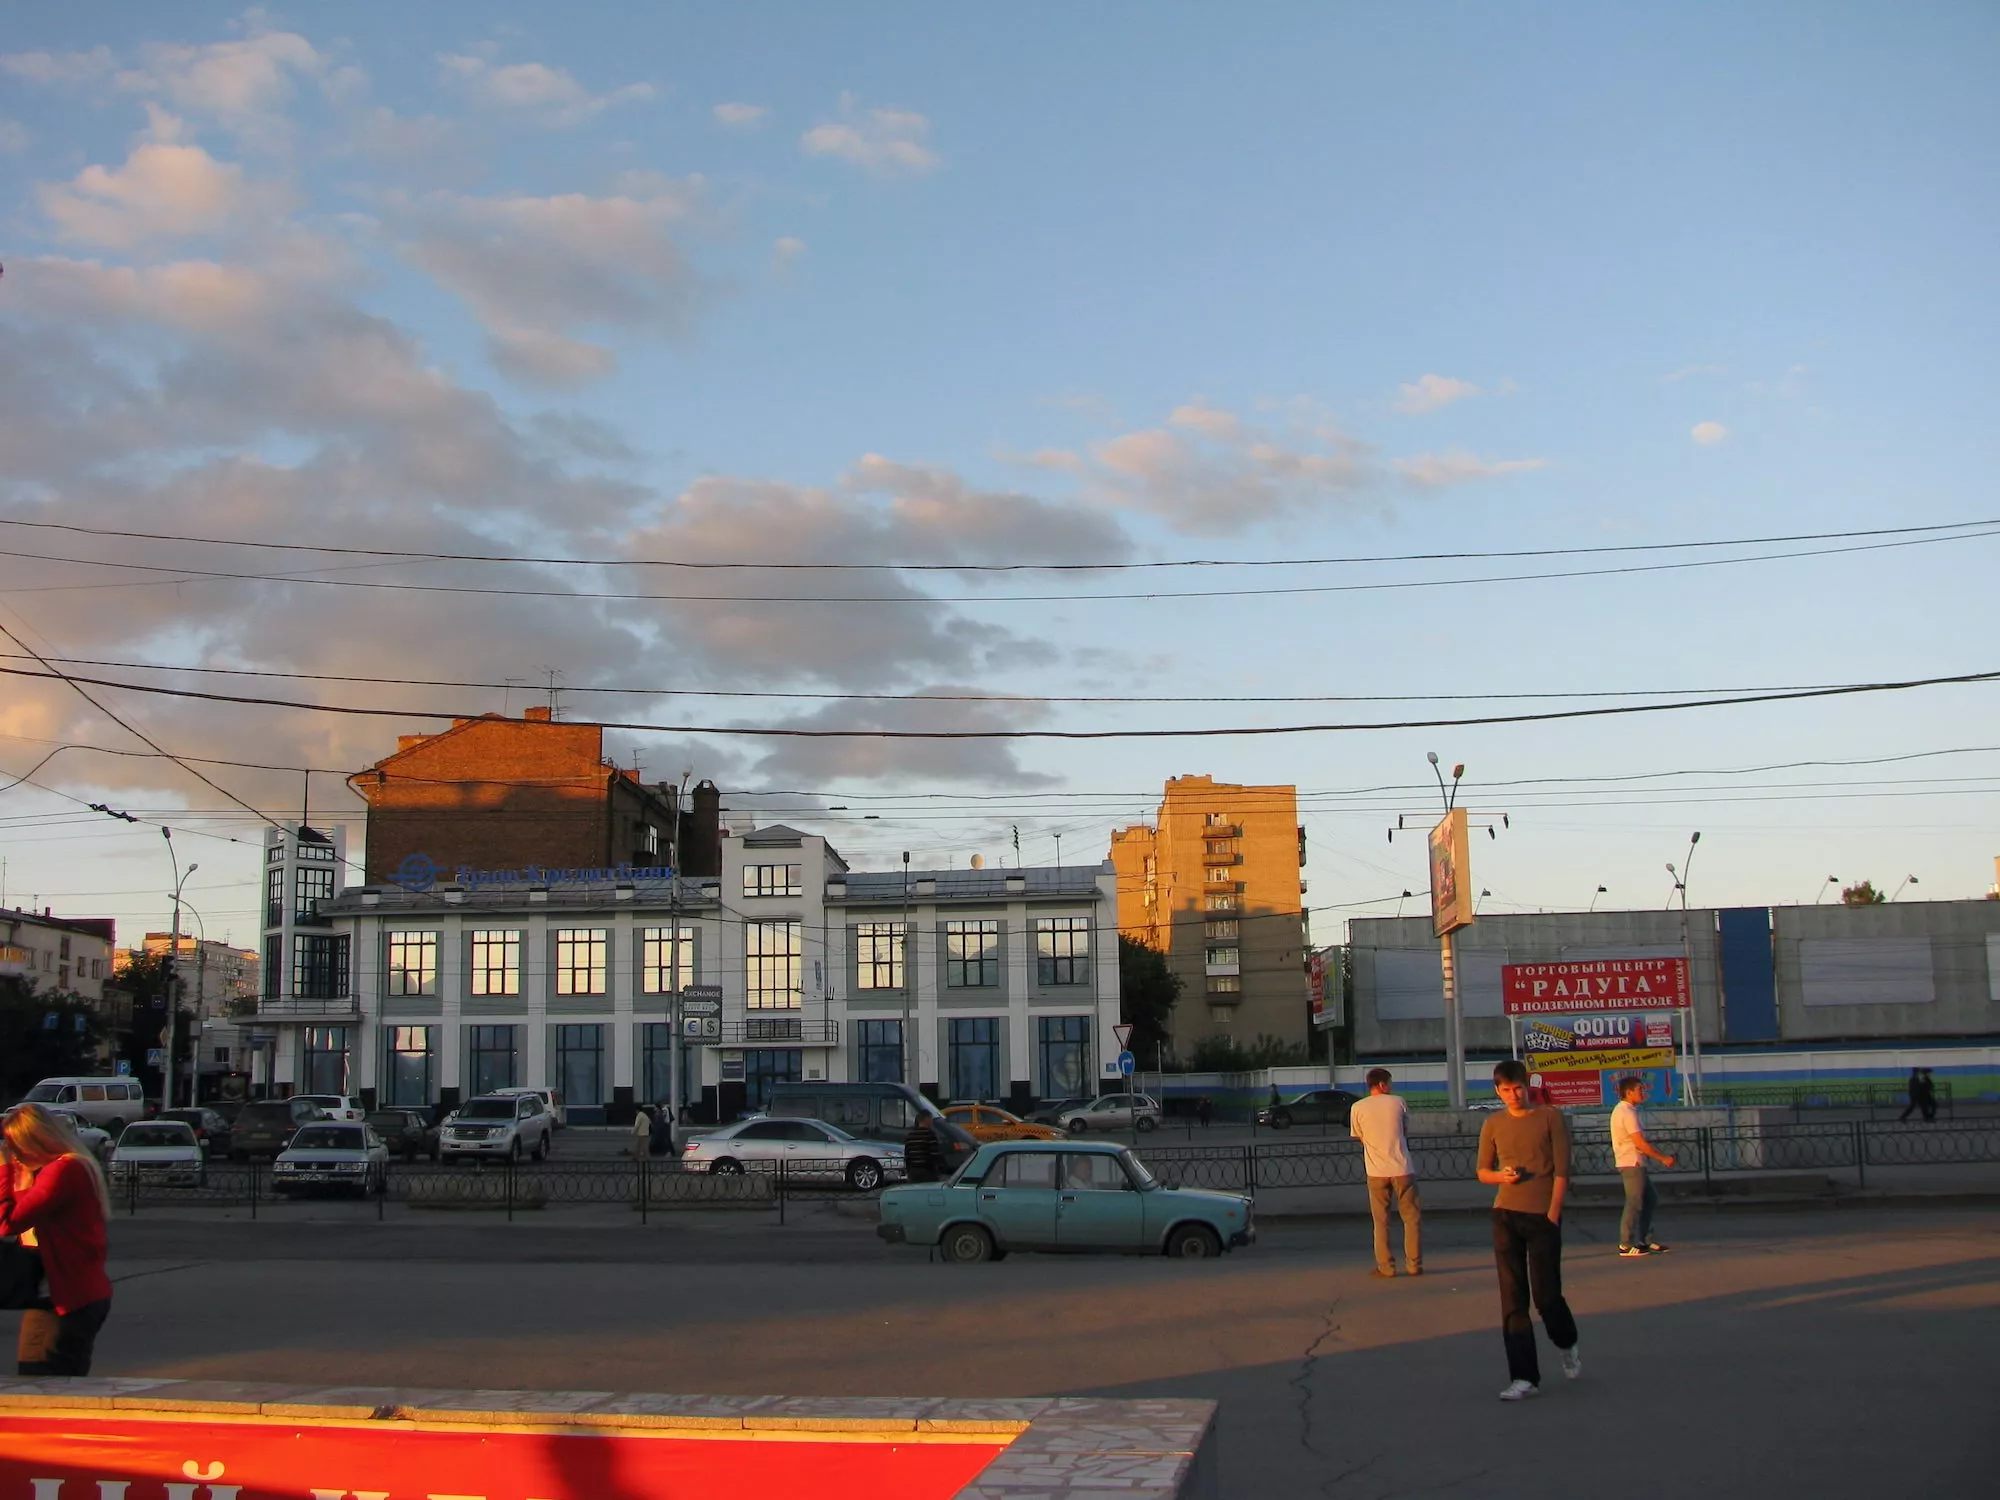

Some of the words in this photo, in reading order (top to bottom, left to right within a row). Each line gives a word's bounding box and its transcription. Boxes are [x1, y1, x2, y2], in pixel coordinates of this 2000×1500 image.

[1515, 962, 1606, 976] ТОРГОВЫЙ
[1612, 960, 1666, 973] ЦЕНТР
[1511, 1002, 1519, 1012] В
[1522, 1000, 1606, 1012] ПОДЗЕМНОМ
[1608, 996, 1674, 1008] ПЕРЕХОДЕ
[1530, 1021, 1574, 1042] СРОЧНОЕ
[1573, 1016, 1630, 1037] ФОТО
[1575, 1037, 1585, 1046] НА
[1588, 1035, 1629, 1046] ДОКУМЕНТЫ
[1538, 1054, 1576, 1068] ПОКУПКА
[1568, 1053, 1606, 1067] ПРОДАЖА
[1599, 1052, 1631, 1065] РЕМОНТ
